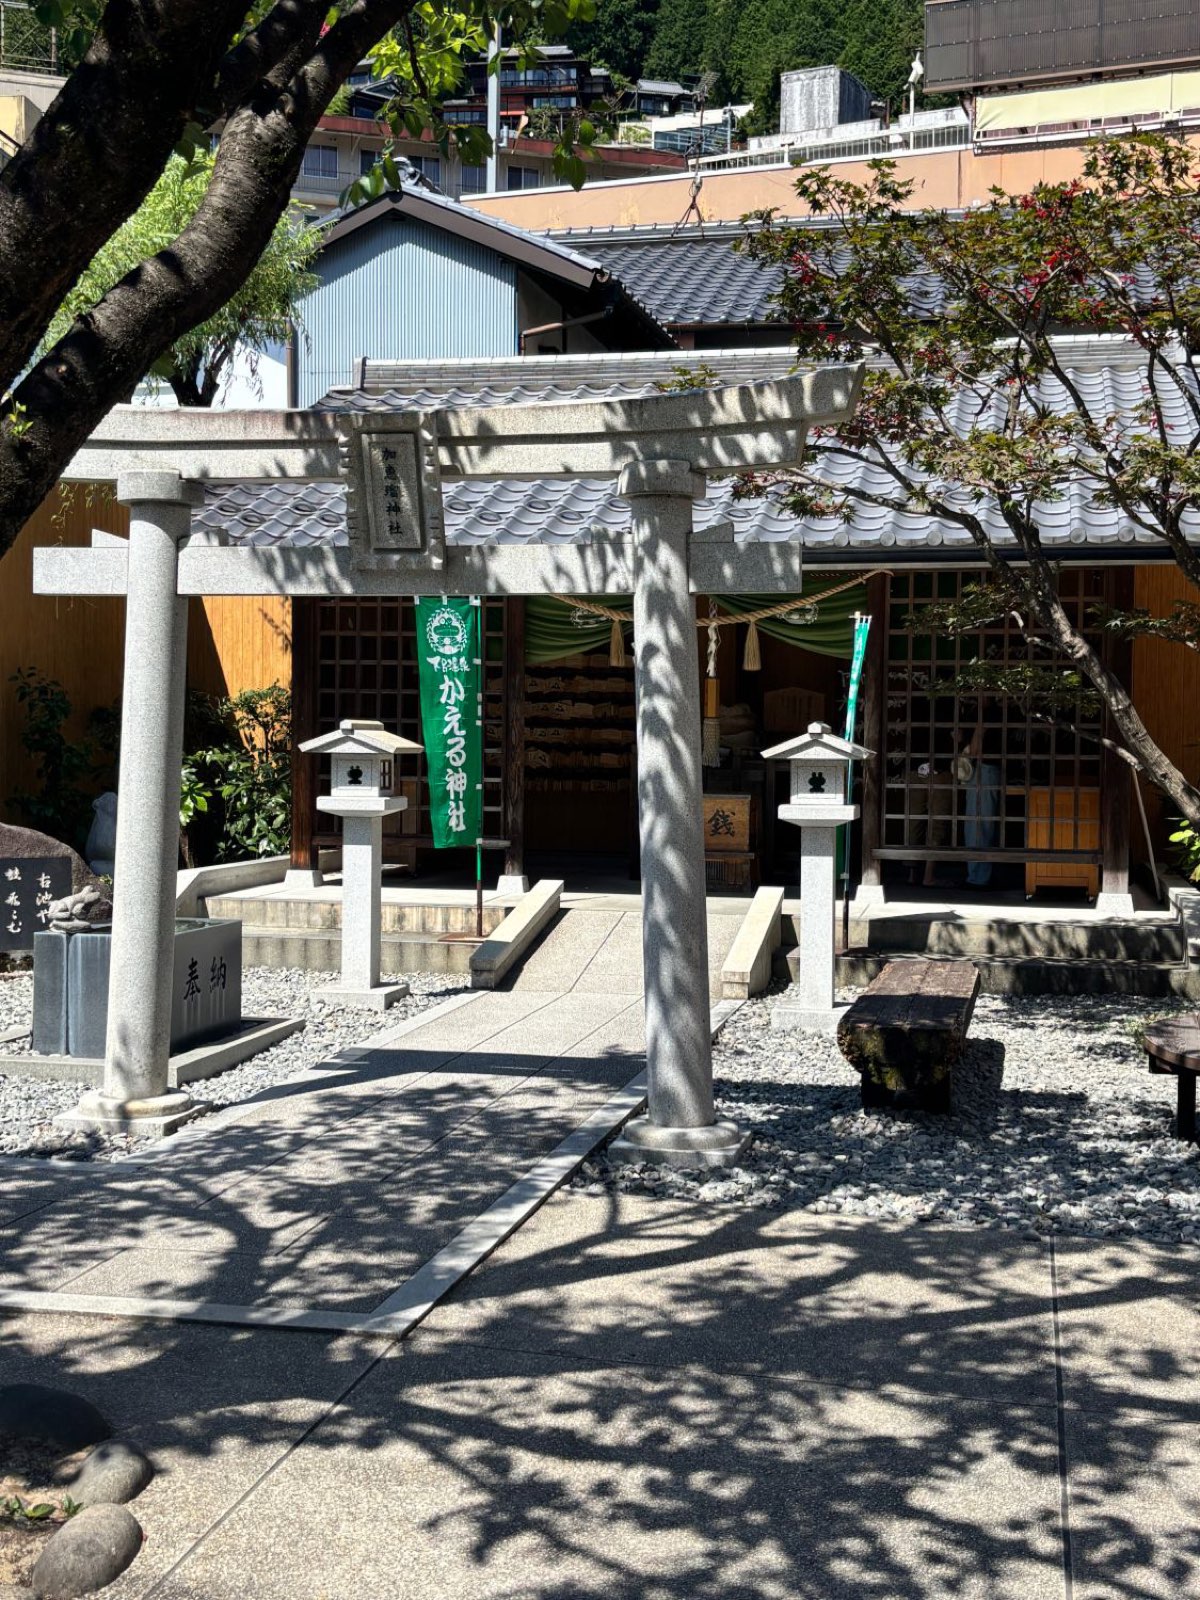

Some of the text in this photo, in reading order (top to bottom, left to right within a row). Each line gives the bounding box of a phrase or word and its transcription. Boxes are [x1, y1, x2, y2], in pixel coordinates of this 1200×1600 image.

[439, 674, 467, 832] かえる神社
[707, 808, 736, 838] 銭
[183, 956, 228, 1002] 奉納
